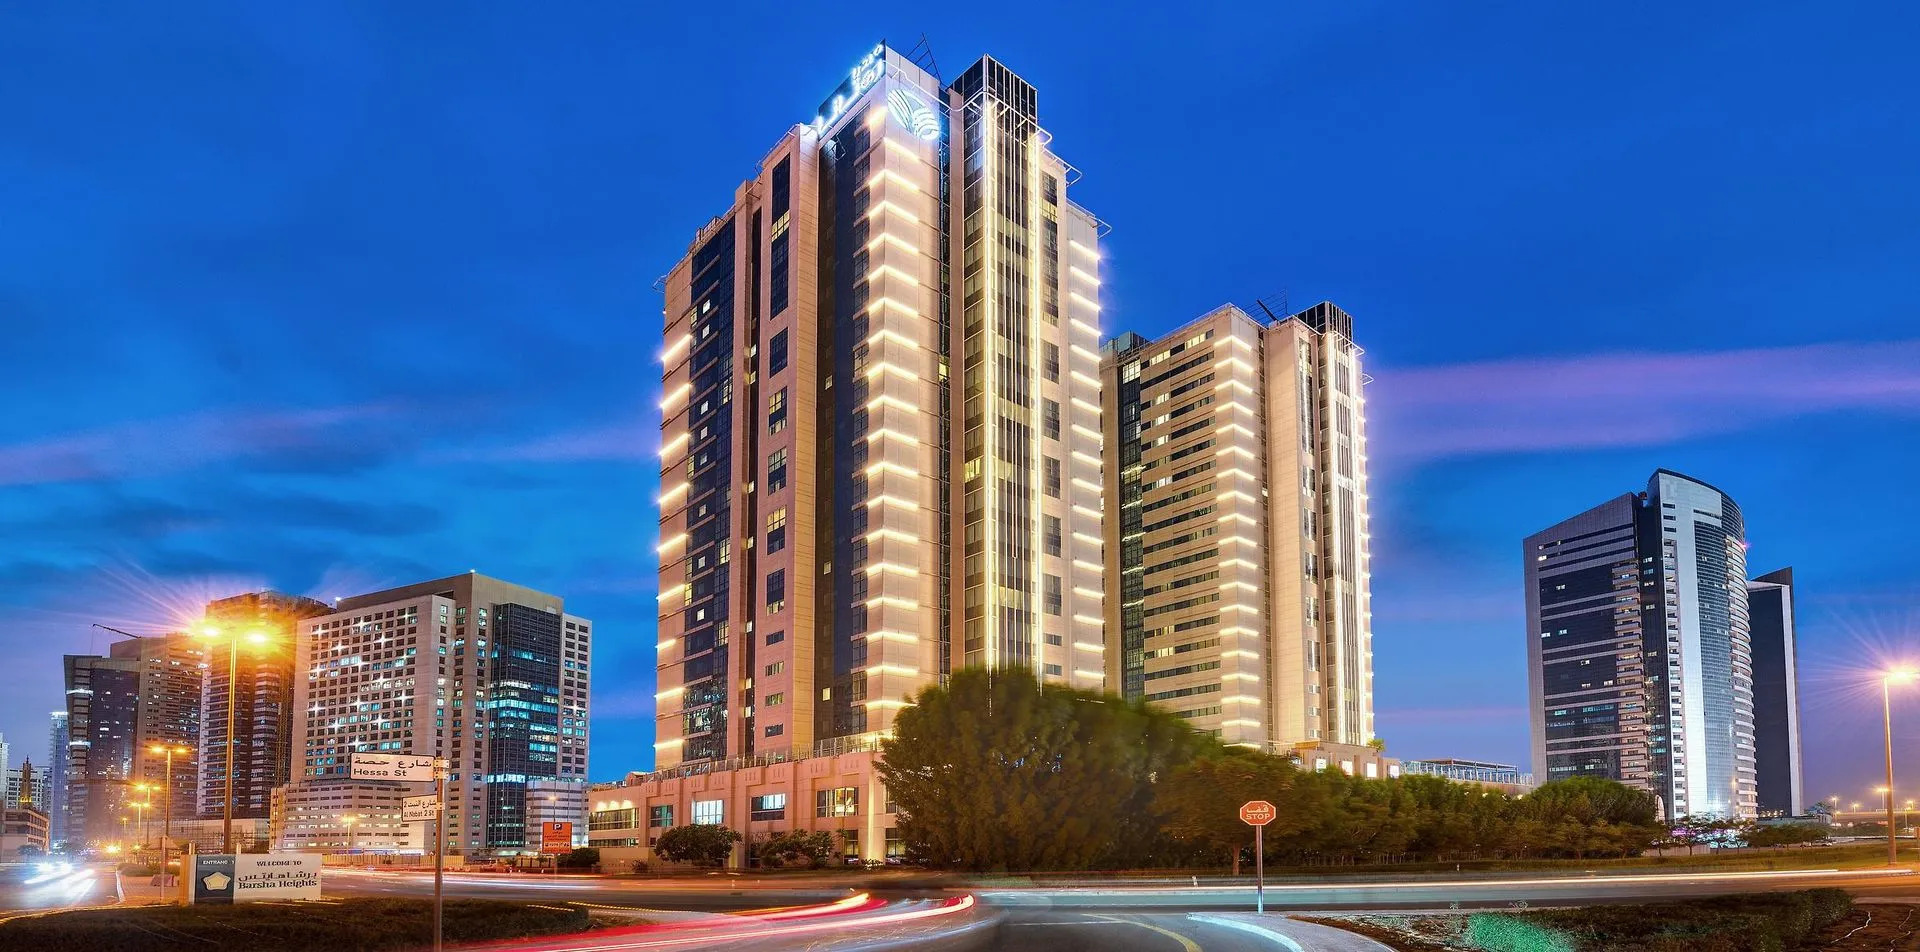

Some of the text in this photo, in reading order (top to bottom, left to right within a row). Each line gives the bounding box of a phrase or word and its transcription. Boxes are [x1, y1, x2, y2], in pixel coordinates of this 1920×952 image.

[398, 760, 432, 768] شارع
[353, 768, 407, 777] Hessa St
[1246, 805, 1268, 813] قف
[238, 879, 317, 889] Barsha Heights
